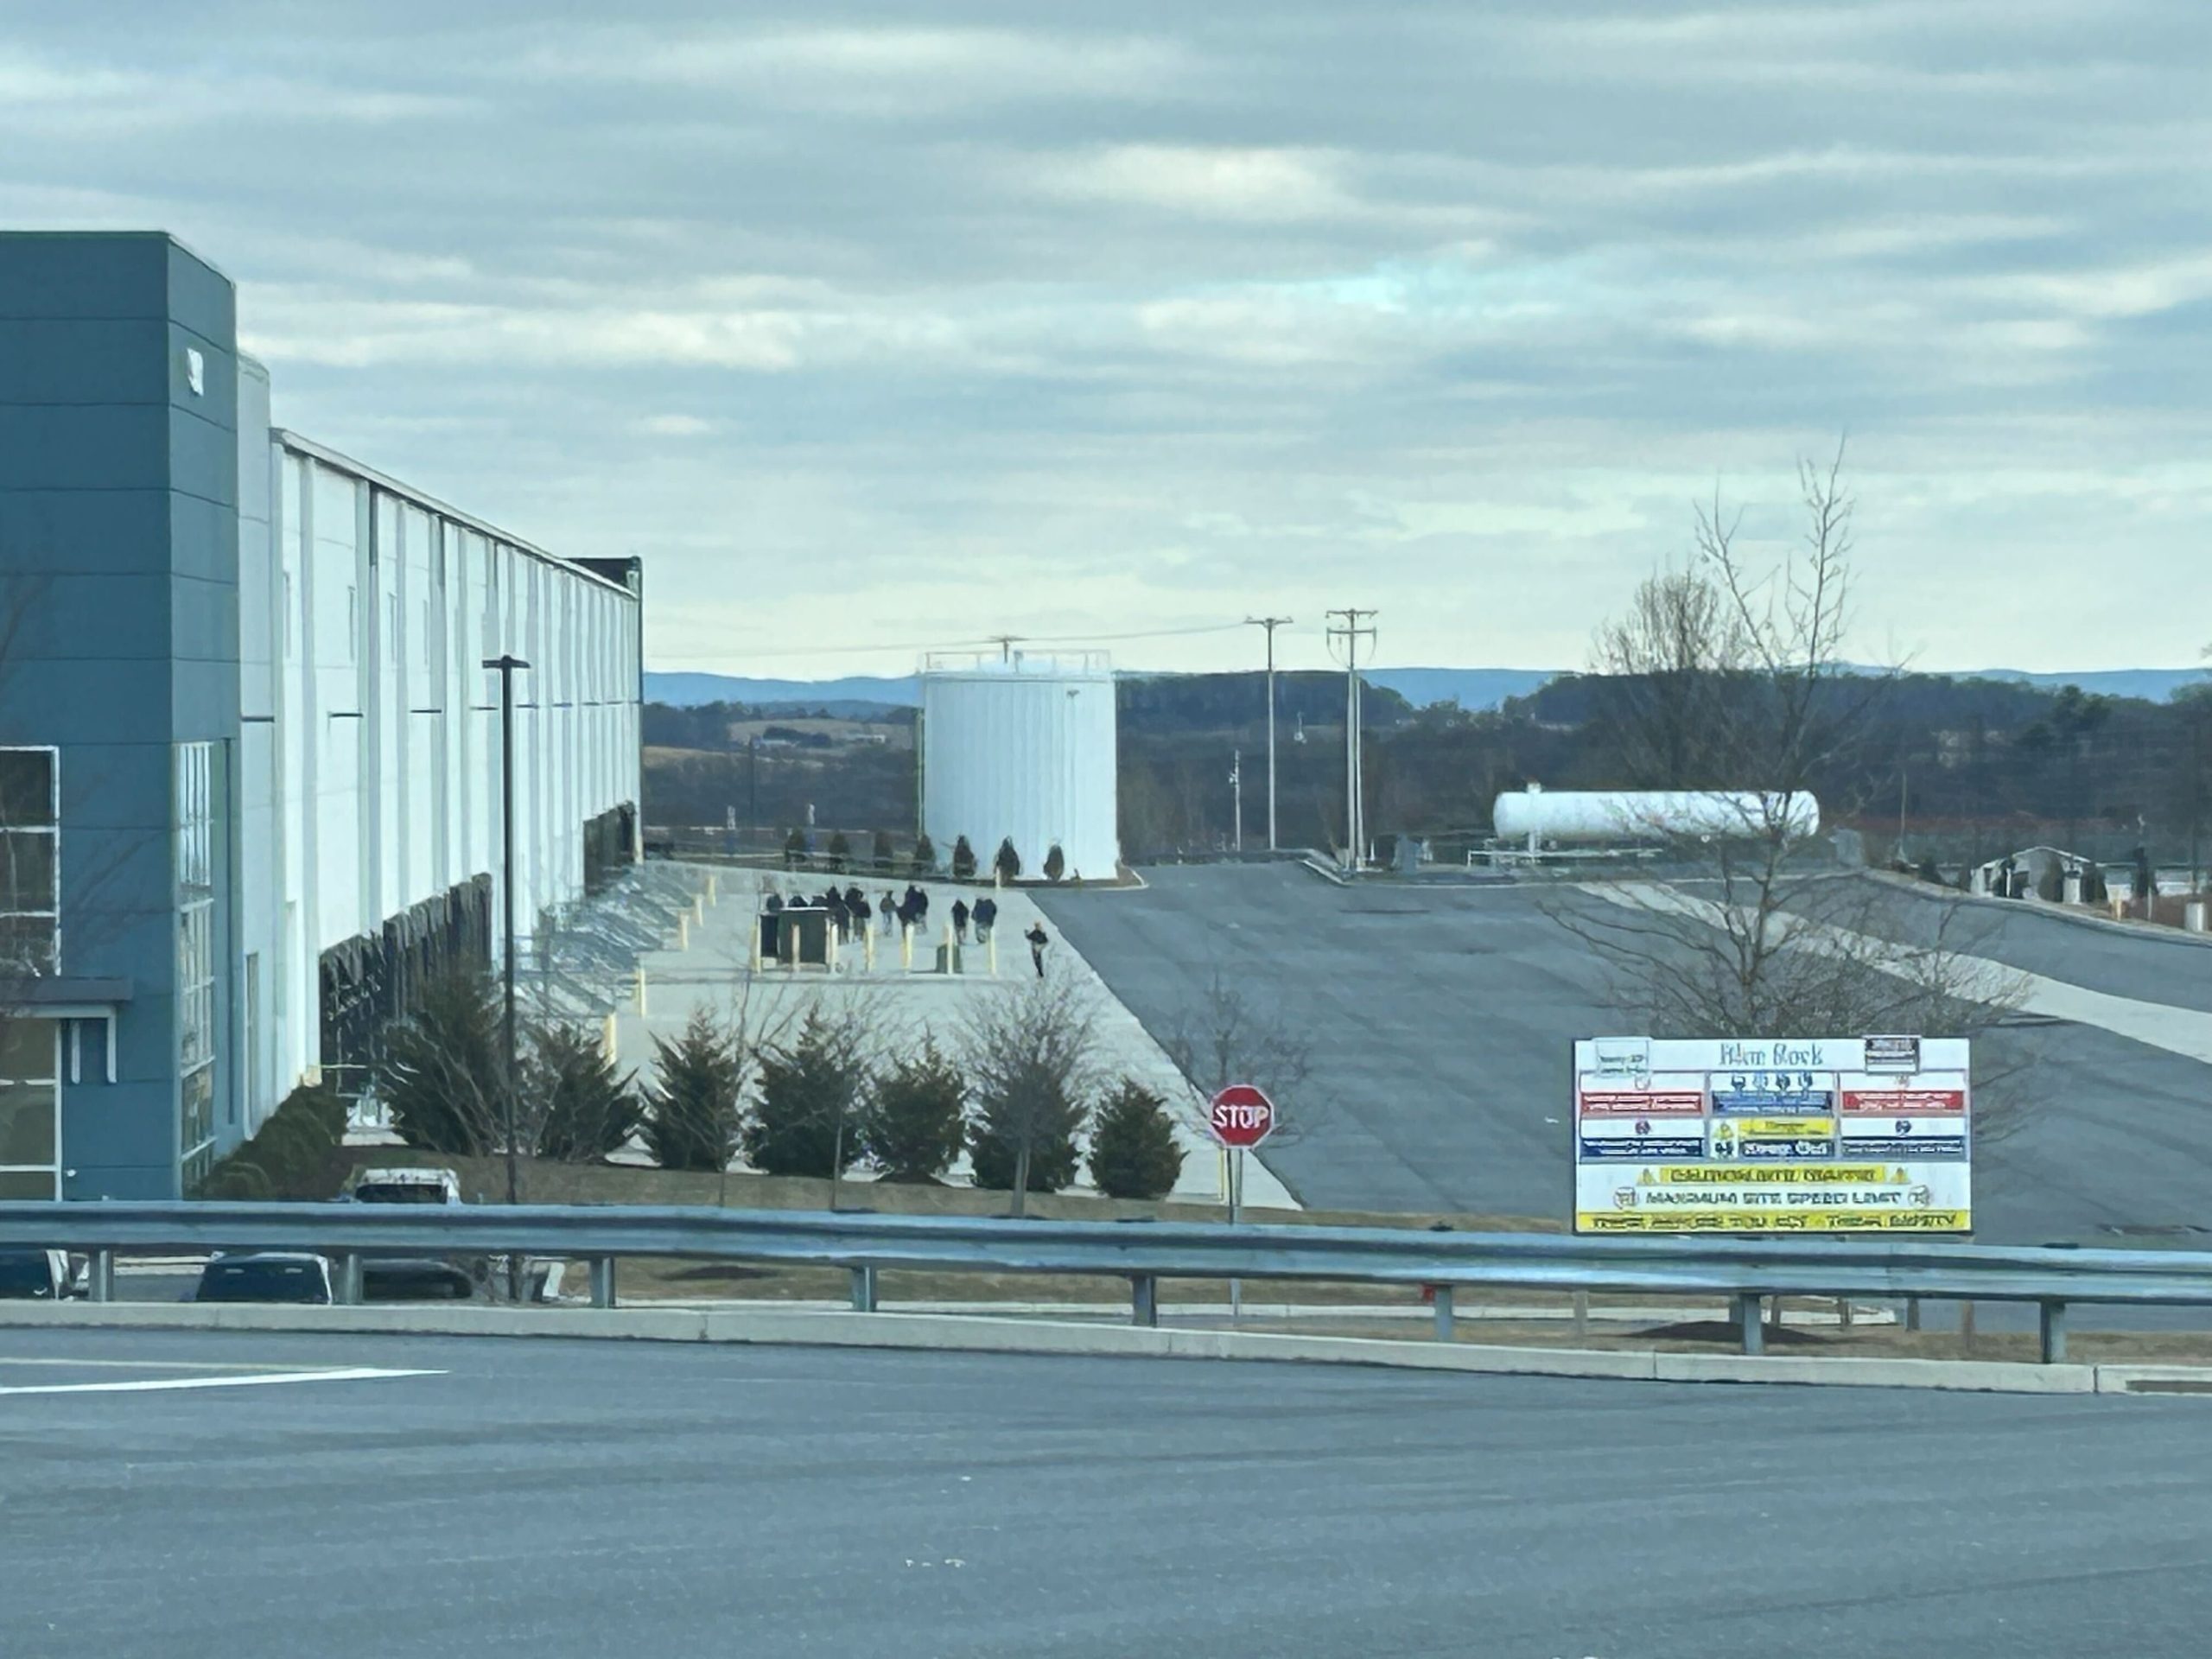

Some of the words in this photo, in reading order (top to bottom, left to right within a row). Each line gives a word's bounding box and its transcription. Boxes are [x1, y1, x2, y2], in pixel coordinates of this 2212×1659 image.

[1212, 1104, 1269, 1128] STOP
[1646, 1192, 1738, 1205] MAXIMUM
[1787, 1192, 1848, 1205] SPEED
